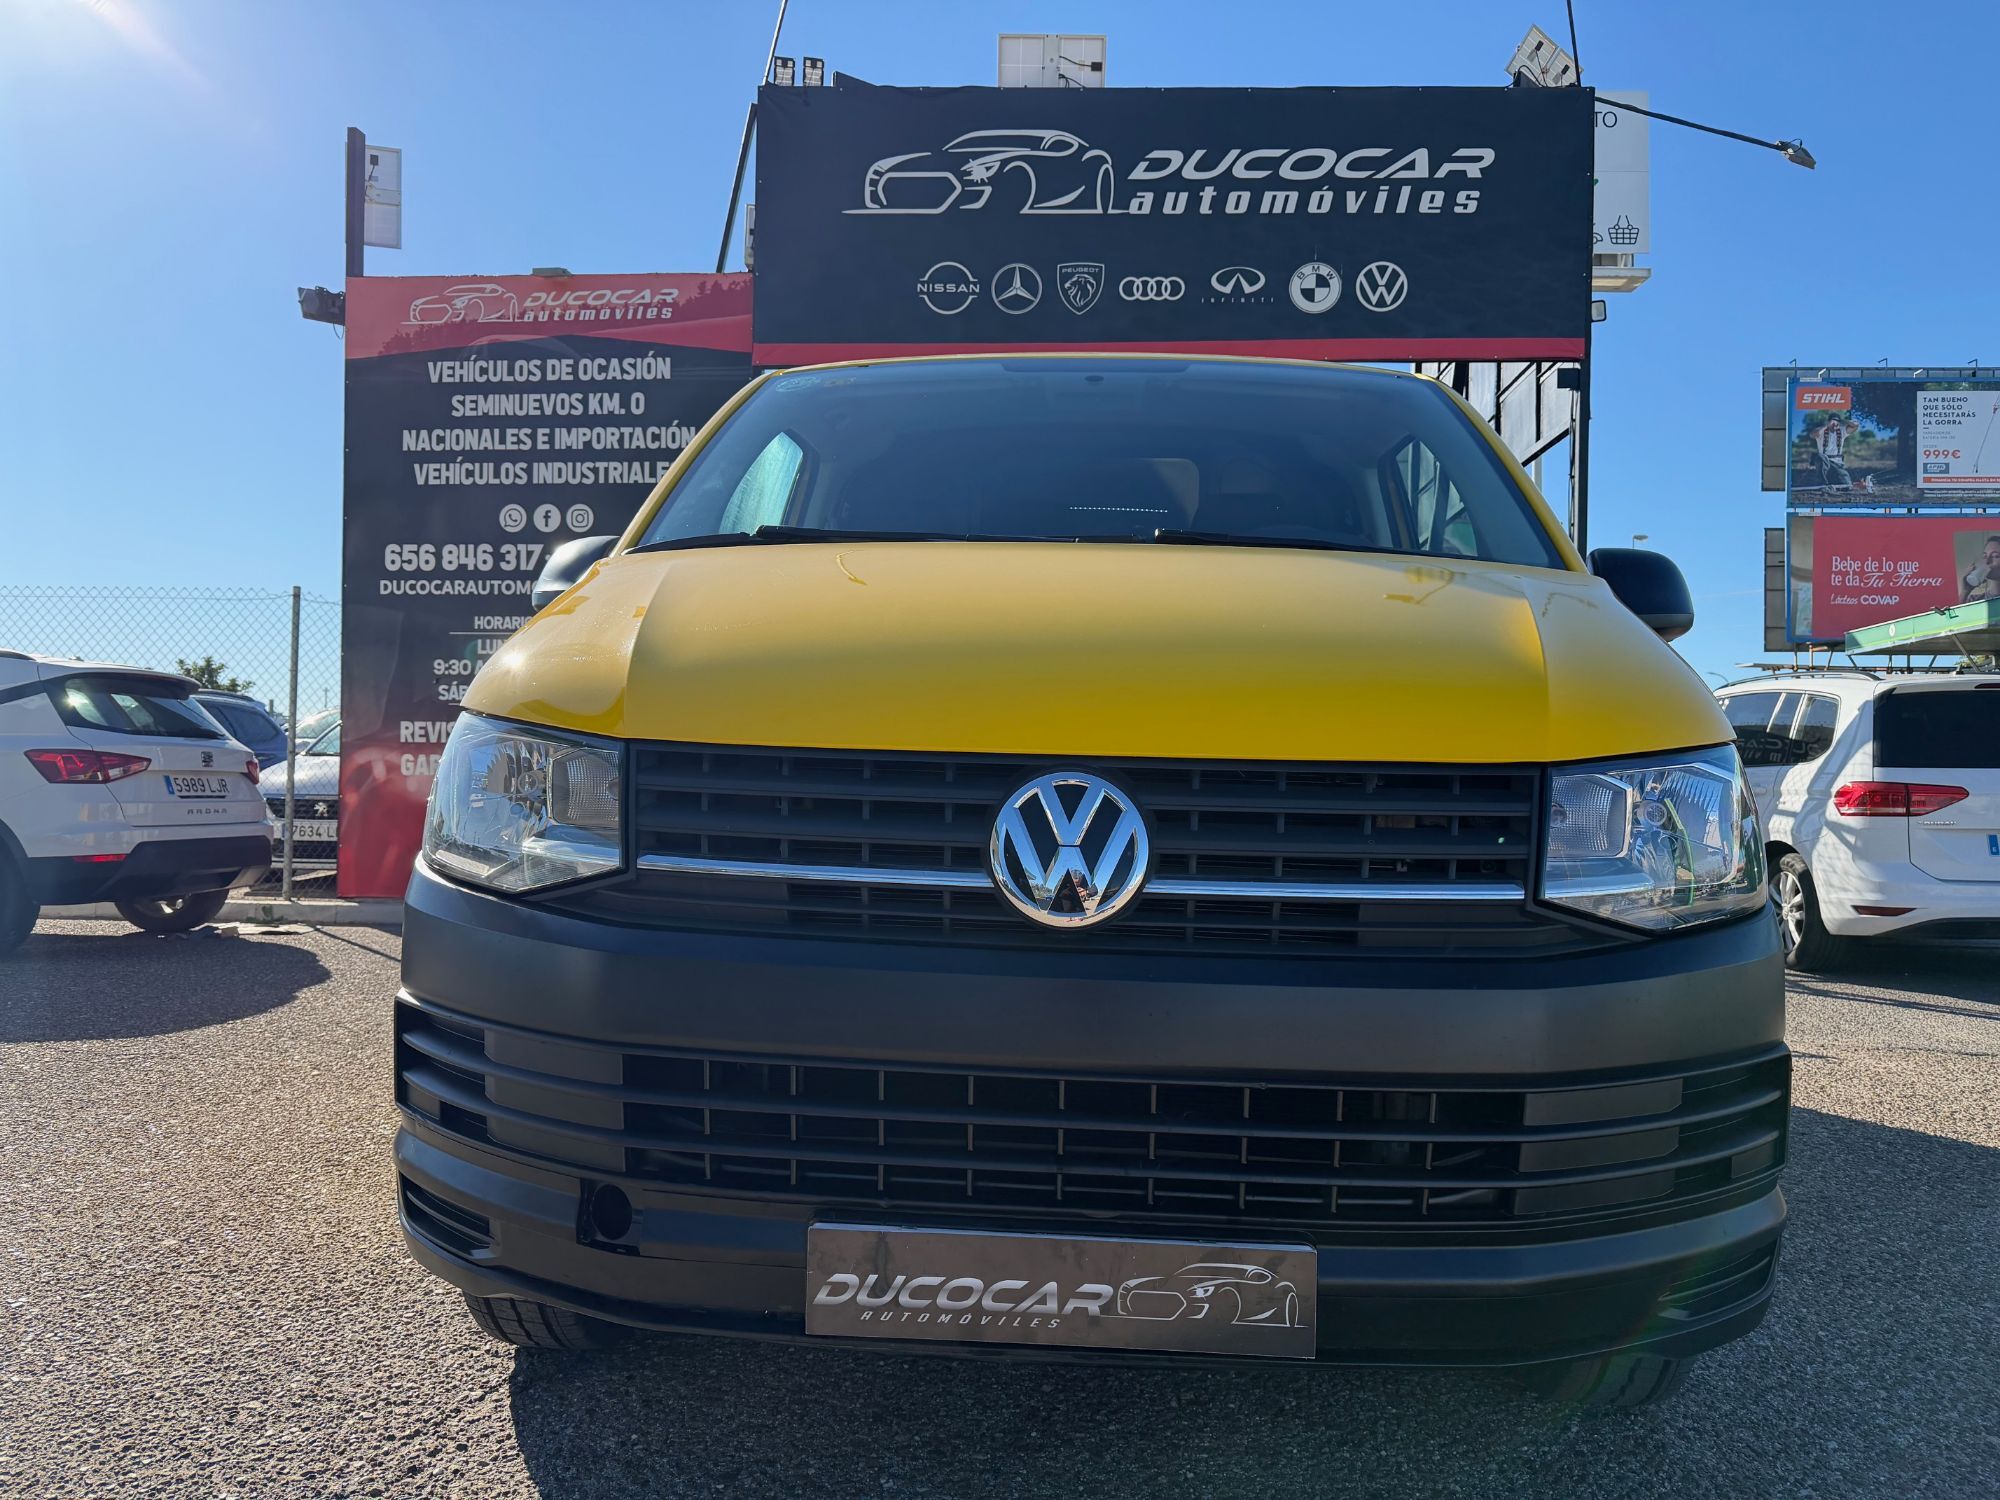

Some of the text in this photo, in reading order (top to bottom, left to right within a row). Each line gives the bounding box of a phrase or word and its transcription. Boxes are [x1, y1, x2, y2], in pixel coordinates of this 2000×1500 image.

[1127, 147, 1495, 180] DUCOCAR
[1129, 184, 1482, 215] automóviles
[917, 283, 980, 293] NISSAN
[523, 288, 679, 307] DUCOCAR
[523, 306, 673, 322] automóviles
[428, 351, 671, 383] VEHÍCULOS DE OCASIÓN
[451, 393, 584, 417] SEMINUEVOS
[588, 393, 625, 415] KM.
[1802, 393, 1845, 403] STIHL
[1941, 403, 1963, 411] SÓLO
[1923, 410, 1976, 418] NECESITARÁS
[402, 420, 696, 452] NACIONALES E IMPORTACIÓN
[1923, 449, 1961, 459] 999€
[414, 457, 673, 486] VEHÍCULOS INDUSTRIALE
[384, 543, 544, 571] 656 846 317
[1832, 556, 1920, 576] Bebe de lo que
[379, 579, 538, 596] DUCOCARAUTOM
[1831, 571, 1944, 588] te da Tu Tierra
[1860, 595, 1900, 605] COVAP
[433, 659, 472, 675] 9:30
[173, 777, 229, 793] 5989 LJR
[812, 1273, 1114, 1317] DUCOCAR
[860, 1310, 1060, 1329] AUTOMÓVILES
